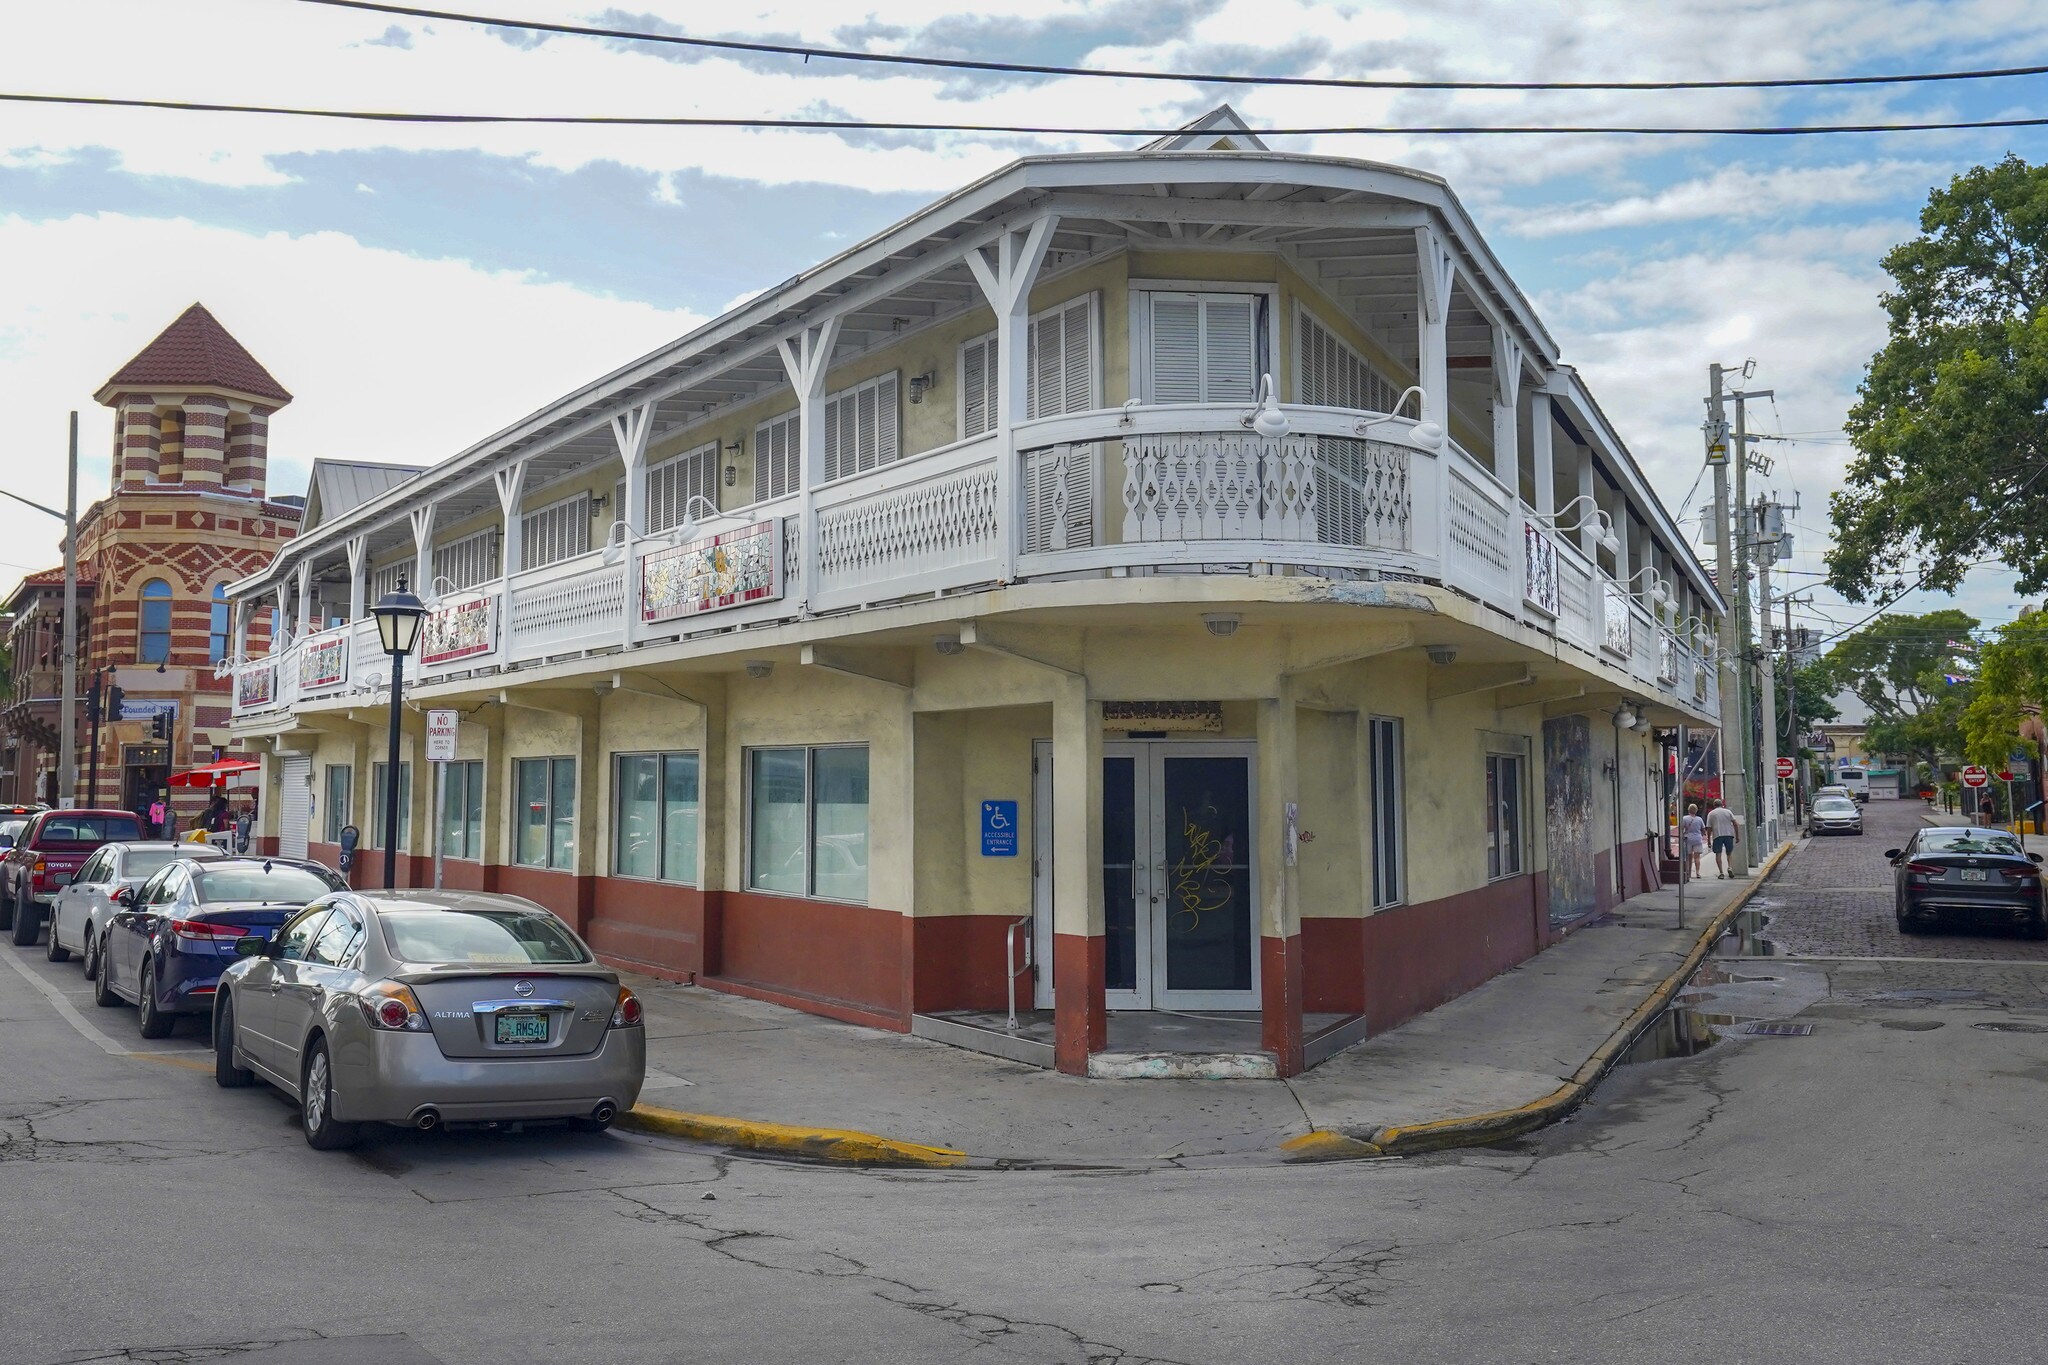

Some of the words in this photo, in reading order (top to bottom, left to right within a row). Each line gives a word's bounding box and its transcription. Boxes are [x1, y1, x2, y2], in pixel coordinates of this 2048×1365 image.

[124, 705, 156, 713] Founded
[437, 716, 448, 726] NO
[430, 727, 455, 736] PARKING
